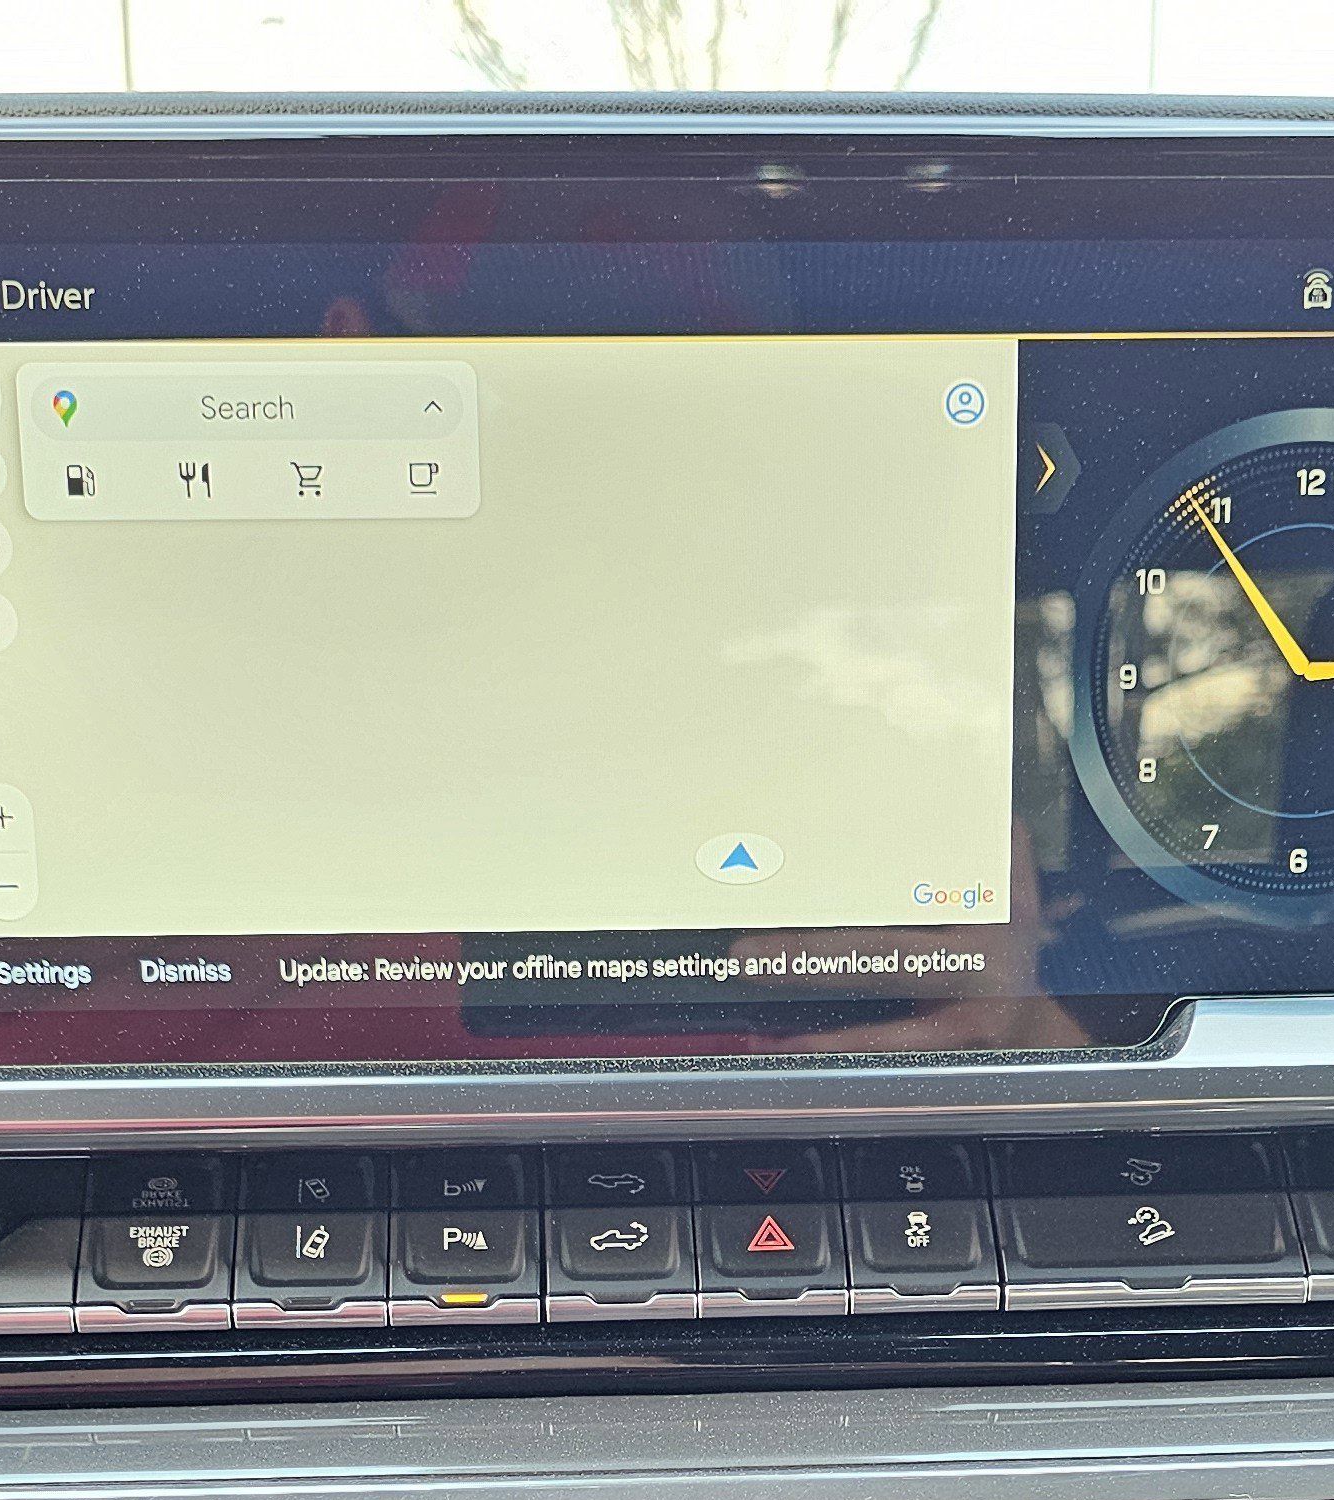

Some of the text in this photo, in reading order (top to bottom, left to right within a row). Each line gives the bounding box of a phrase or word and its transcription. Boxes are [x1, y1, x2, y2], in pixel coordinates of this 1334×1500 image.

[1, 280, 95, 310] Driver
[200, 394, 295, 421] Search
[1295, 469, 1327, 497] 12
[1209, 497, 1233, 524] 11
[1135, 569, 1166, 596] 10
[1119, 664, 1138, 690] 9
[1137, 757, 1158, 783] 8
[1201, 825, 1219, 850] 7
[1288, 848, 1309, 875] 6
[913, 882, 995, 909] Google
[140, 957, 233, 984] Dismiss
[279, 949, 986, 987] Update: Review your offline maps settings and download options
[129, 1225, 189, 1237] EXHAUST
[137, 1236, 180, 1249] BRAKE
[907, 1235, 930, 1247] OFF
